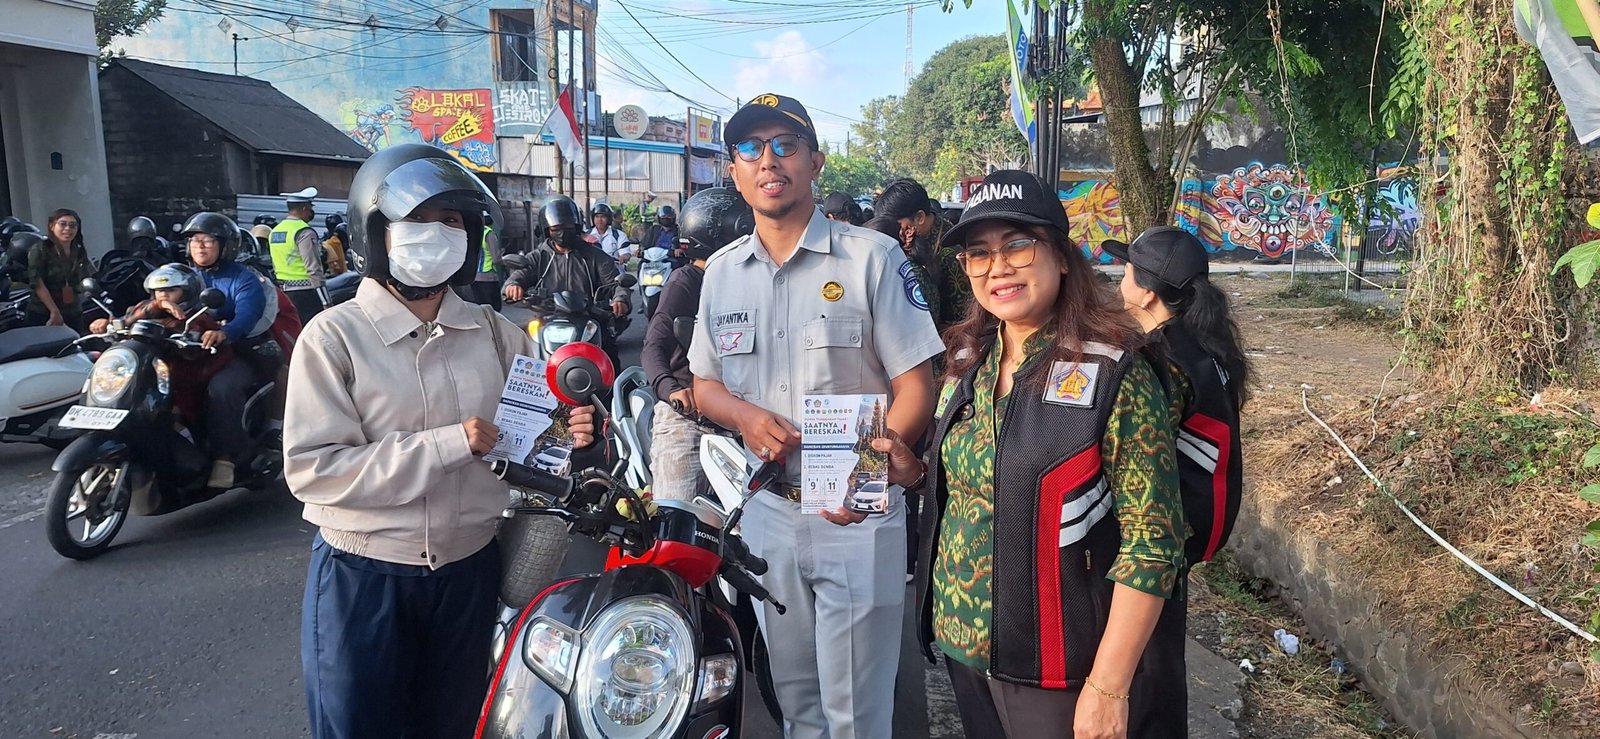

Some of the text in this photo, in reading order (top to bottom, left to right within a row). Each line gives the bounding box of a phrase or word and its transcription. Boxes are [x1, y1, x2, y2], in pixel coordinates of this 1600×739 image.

[431, 93, 485, 107] LOKAL
[500, 89, 547, 106] SKATE
[433, 108, 462, 117] SPACE
[443, 118, 474, 142] COFFEE
[716, 312, 749, 327] JAYANTIKA
[509, 380, 542, 392] SAATNYA
[515, 437, 523, 446] 11
[810, 481, 816, 490] 9
[828, 482, 836, 490] 11
[694, 530, 720, 544] HONDA
